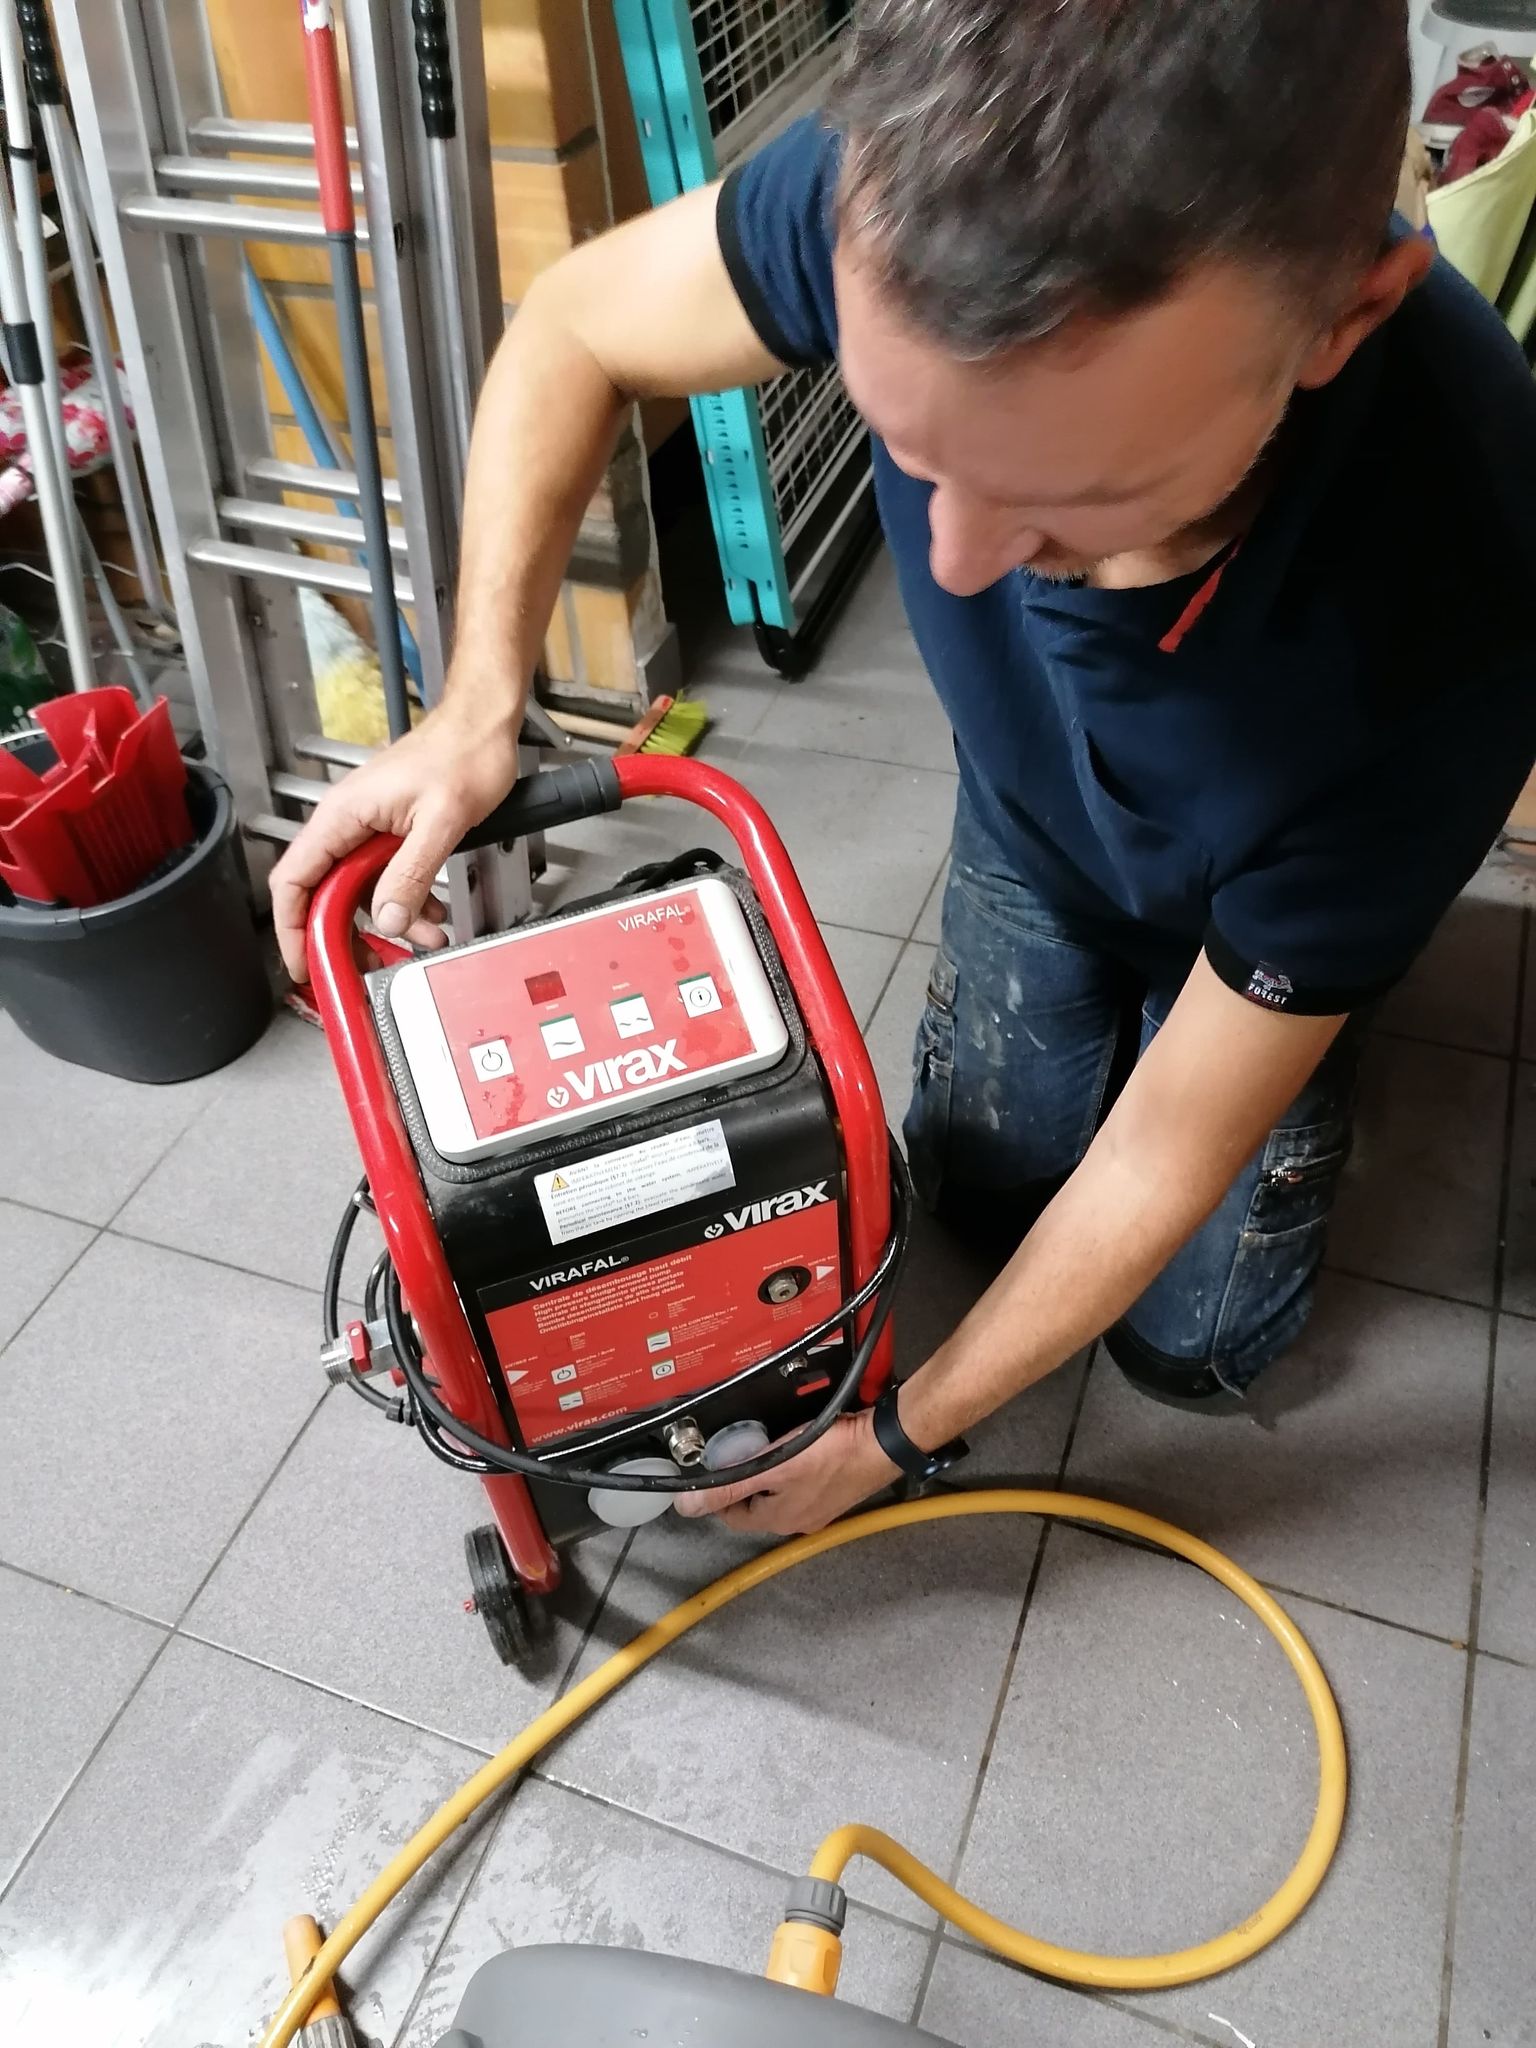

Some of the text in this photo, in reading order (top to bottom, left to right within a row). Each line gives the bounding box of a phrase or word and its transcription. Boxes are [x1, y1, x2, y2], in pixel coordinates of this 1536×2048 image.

[1248, 982, 1288, 1005] FOREST
[563, 1038, 688, 1101] virax
[723, 1180, 829, 1231] virax
[532, 1295, 570, 1310] Centrale
[585, 1270, 647, 1294] désembouage
[648, 1262, 668, 1273] haut
[670, 1254, 692, 1266] débit
[534, 1268, 671, 1317] High pressure sludge removal pump
[624, 1297, 640, 1306] met
[640, 1291, 660, 1301] hoog
[536, 1309, 568, 1322] Centrale
[537, 1316, 565, 1328] Bomba
[531, 1406, 627, 1443] www.virax.com
